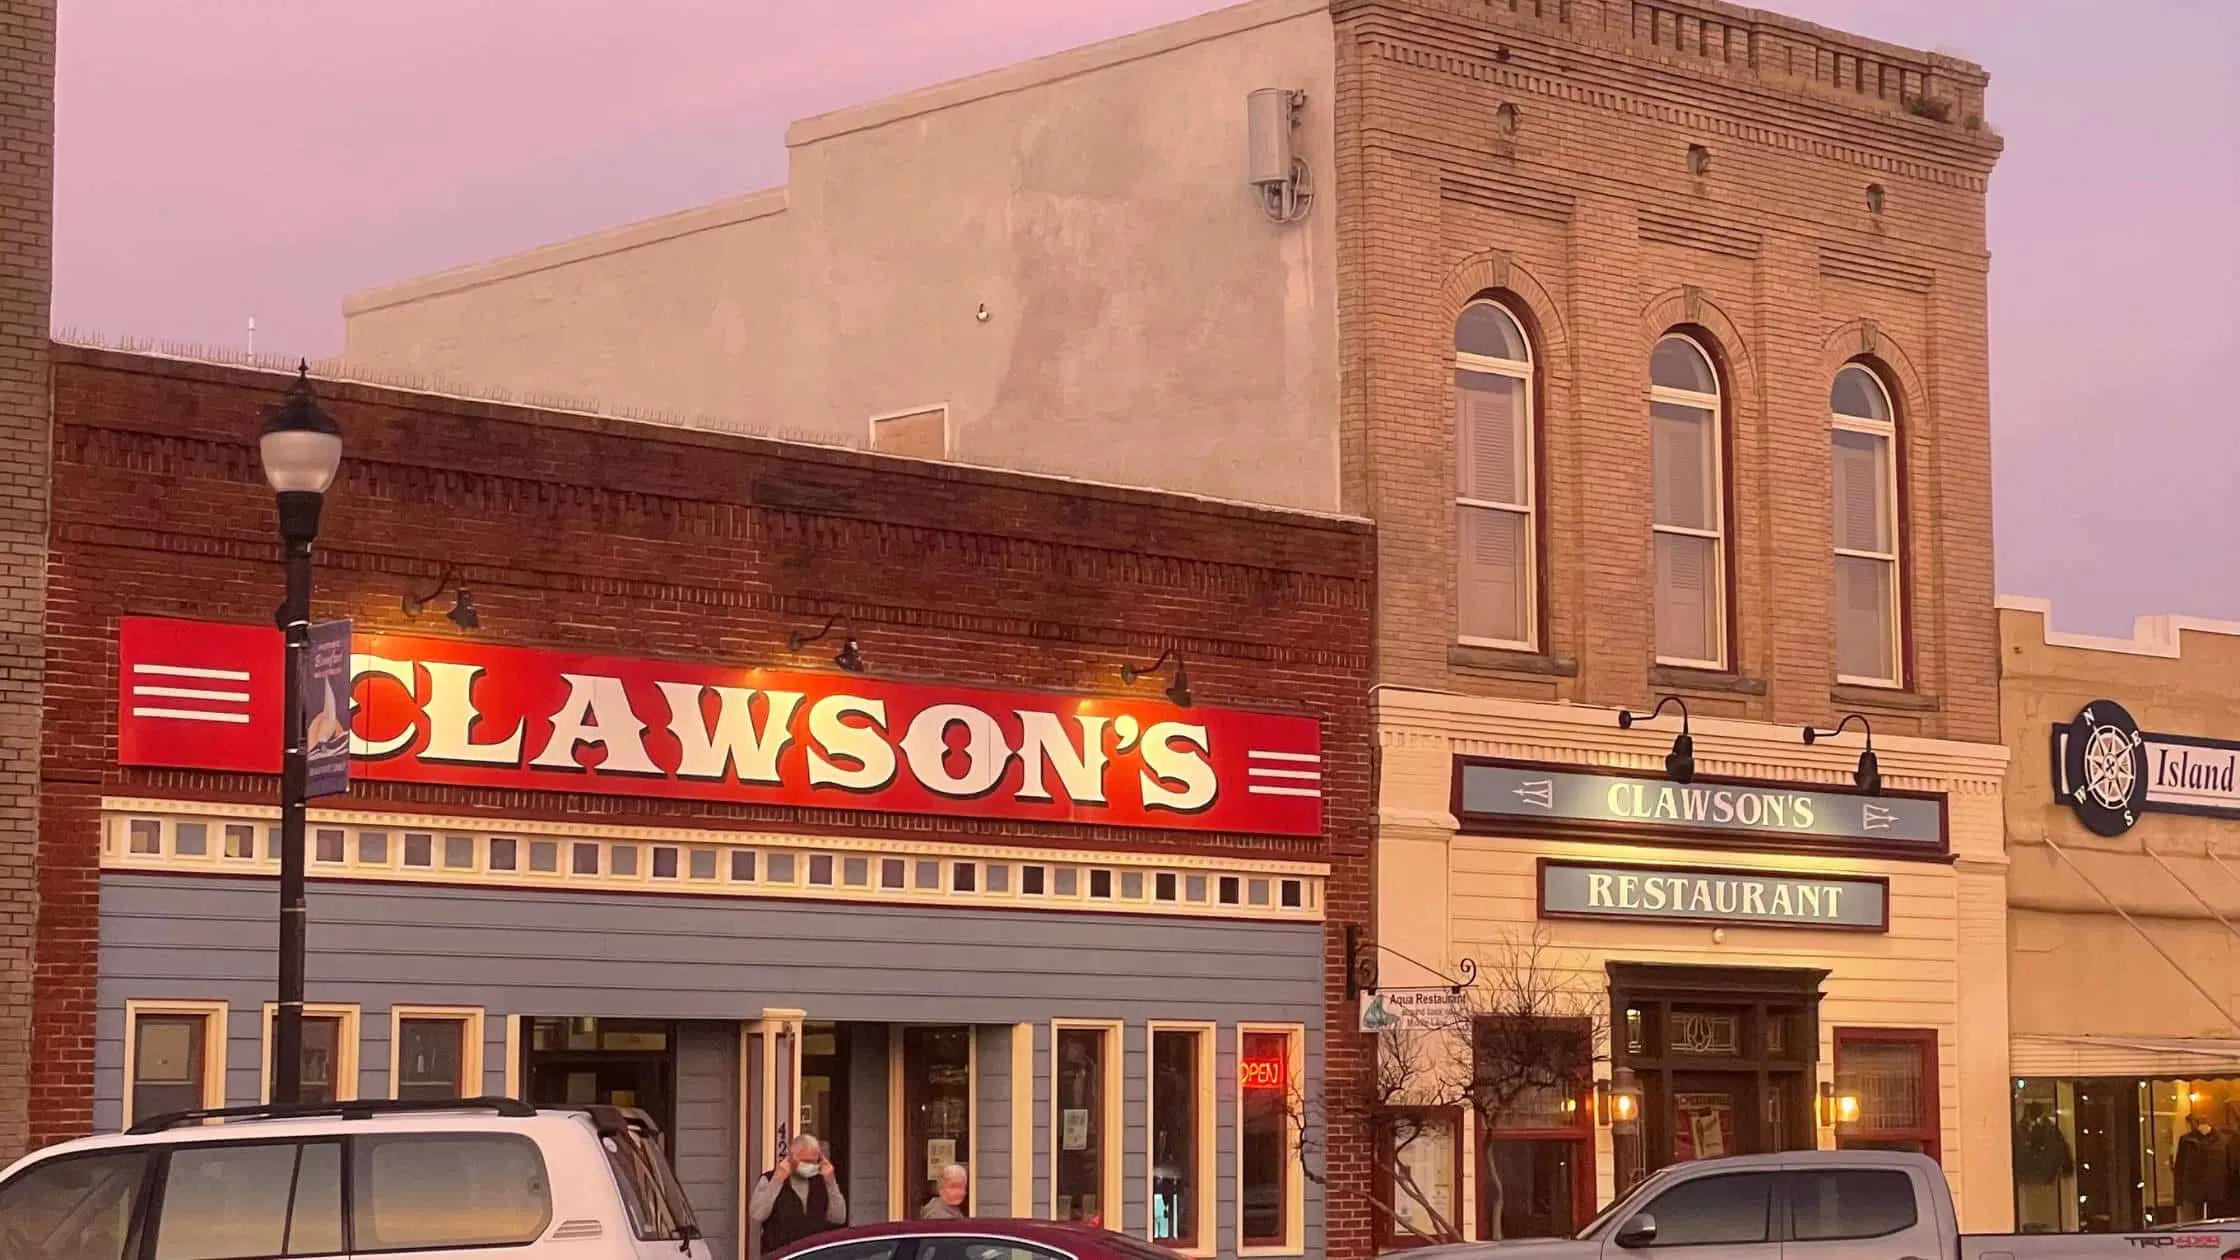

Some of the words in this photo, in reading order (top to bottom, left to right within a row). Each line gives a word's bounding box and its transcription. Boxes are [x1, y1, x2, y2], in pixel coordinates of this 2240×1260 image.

[2082, 708, 2095, 726] N
[350, 653, 1218, 813] CLAWSON'S
[2157, 749, 2235, 792] Island
[2074, 786, 2087, 804] W
[1607, 782, 1816, 829] CLAWSON'S
[2123, 809, 2134, 827] S
[1587, 873, 1844, 918] RESTAURANT
[1390, 993, 1413, 1006] Aqua
[1416, 993, 1466, 1005] Restaurant
[1239, 1061, 1279, 1084] OPEN
[2124, 1236, 2174, 1249] TRD
